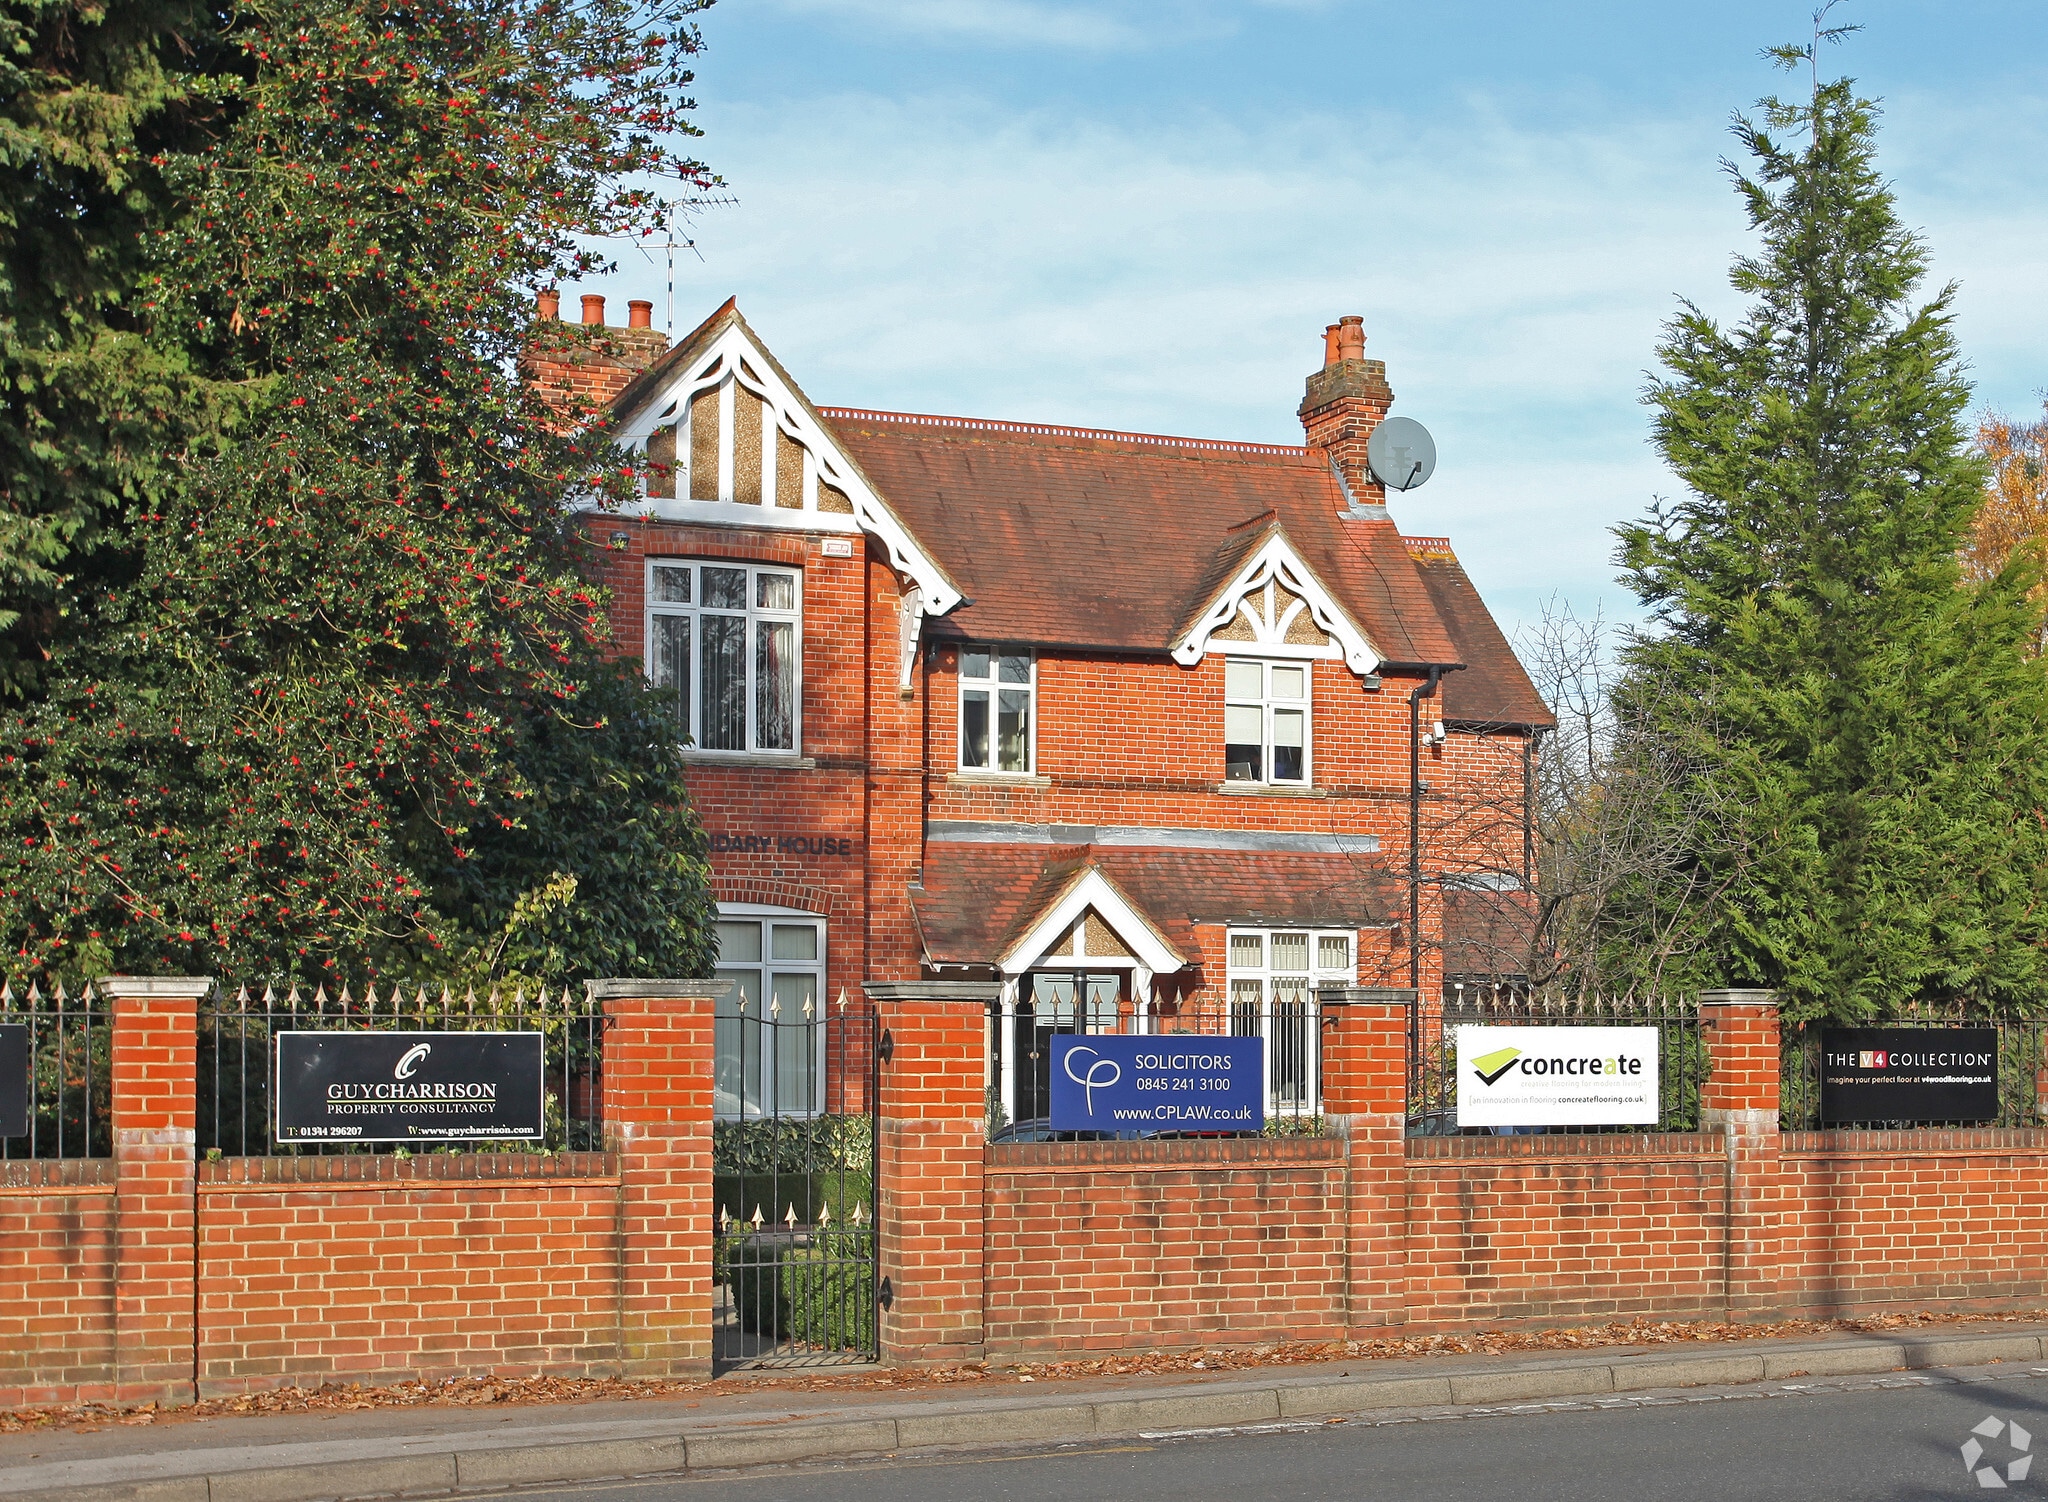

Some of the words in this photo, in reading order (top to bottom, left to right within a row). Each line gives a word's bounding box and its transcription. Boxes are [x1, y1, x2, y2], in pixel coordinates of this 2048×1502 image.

[777, 836, 851, 856] HOUSE
[1135, 1055, 1232, 1070] SOLICITORS
[1520, 1054, 1642, 1075] concreate
[1827, 1053, 1855, 1066] THE
[1860, 1052, 1885, 1066] V4
[1136, 1078, 1168, 1091] 0845
[1172, 1078, 1194, 1091] 241
[1199, 1078, 1230, 1091] 3100
[1521, 1080, 1549, 1088] creative
[1552, 1080, 1579, 1088] flooring
[1581, 1080, 1592, 1088] for
[1594, 1080, 1620, 1088] modern
[1827, 1076, 1853, 1085] imagine
[1855, 1077, 1870, 1085] your
[1871, 1076, 1895, 1085] perfect
[1897, 1076, 1912, 1084] floor
[1913, 1076, 1920, 1084] at
[1483, 1096, 1519, 1104] innovation
[1521, 1096, 1528, 1104] in
[1529, 1095, 1557, 1105] flooring
[327, 1104, 395, 1115] PROPERTY
[399, 1103, 496, 1114] CONSULTANCY
[1113, 1105, 1252, 1121] www.CPLAW.co.uk
[286, 1126, 298, 1136] T:
[300, 1126, 328, 1136] 01344
[330, 1126, 363, 1136] 296207
